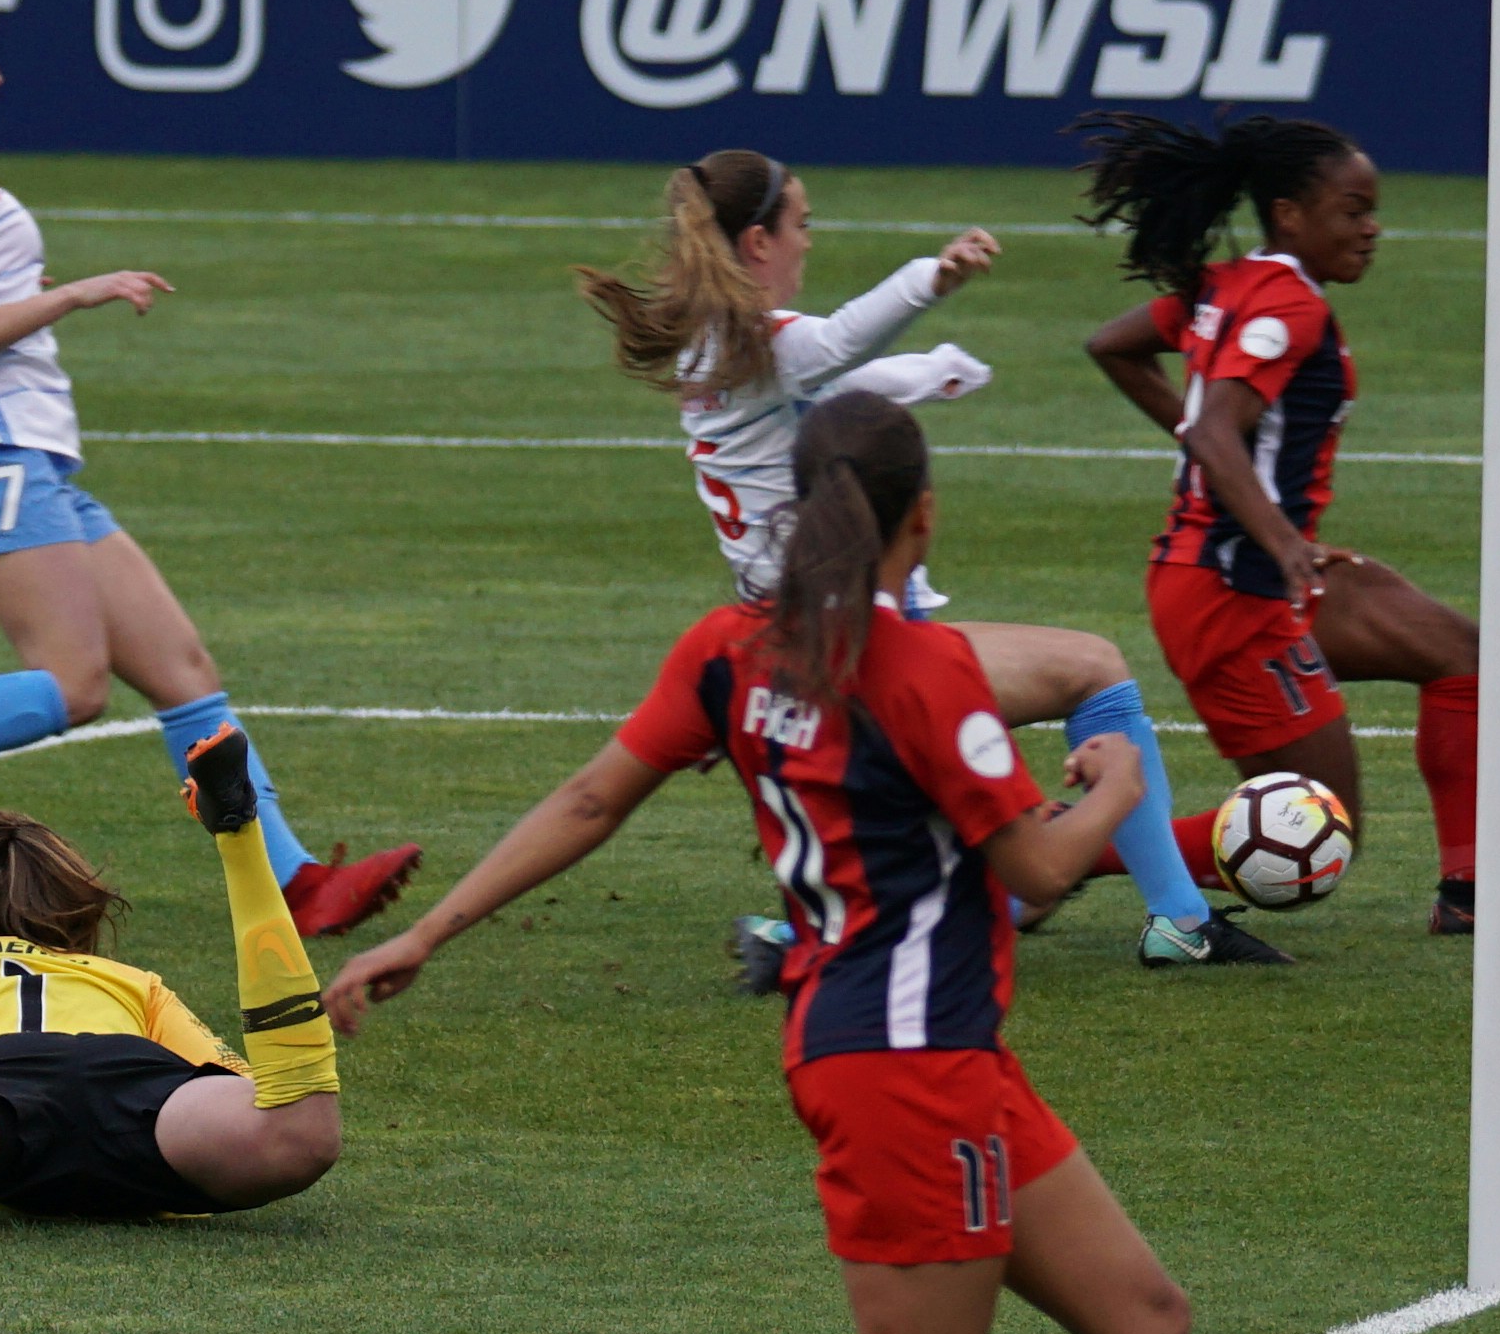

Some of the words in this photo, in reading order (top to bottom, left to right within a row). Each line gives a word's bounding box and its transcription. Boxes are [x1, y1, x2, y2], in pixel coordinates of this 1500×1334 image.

[1262, 631, 1340, 716] 14
[0, 957, 48, 1034] 1
[952, 1134, 1011, 1233] 11
